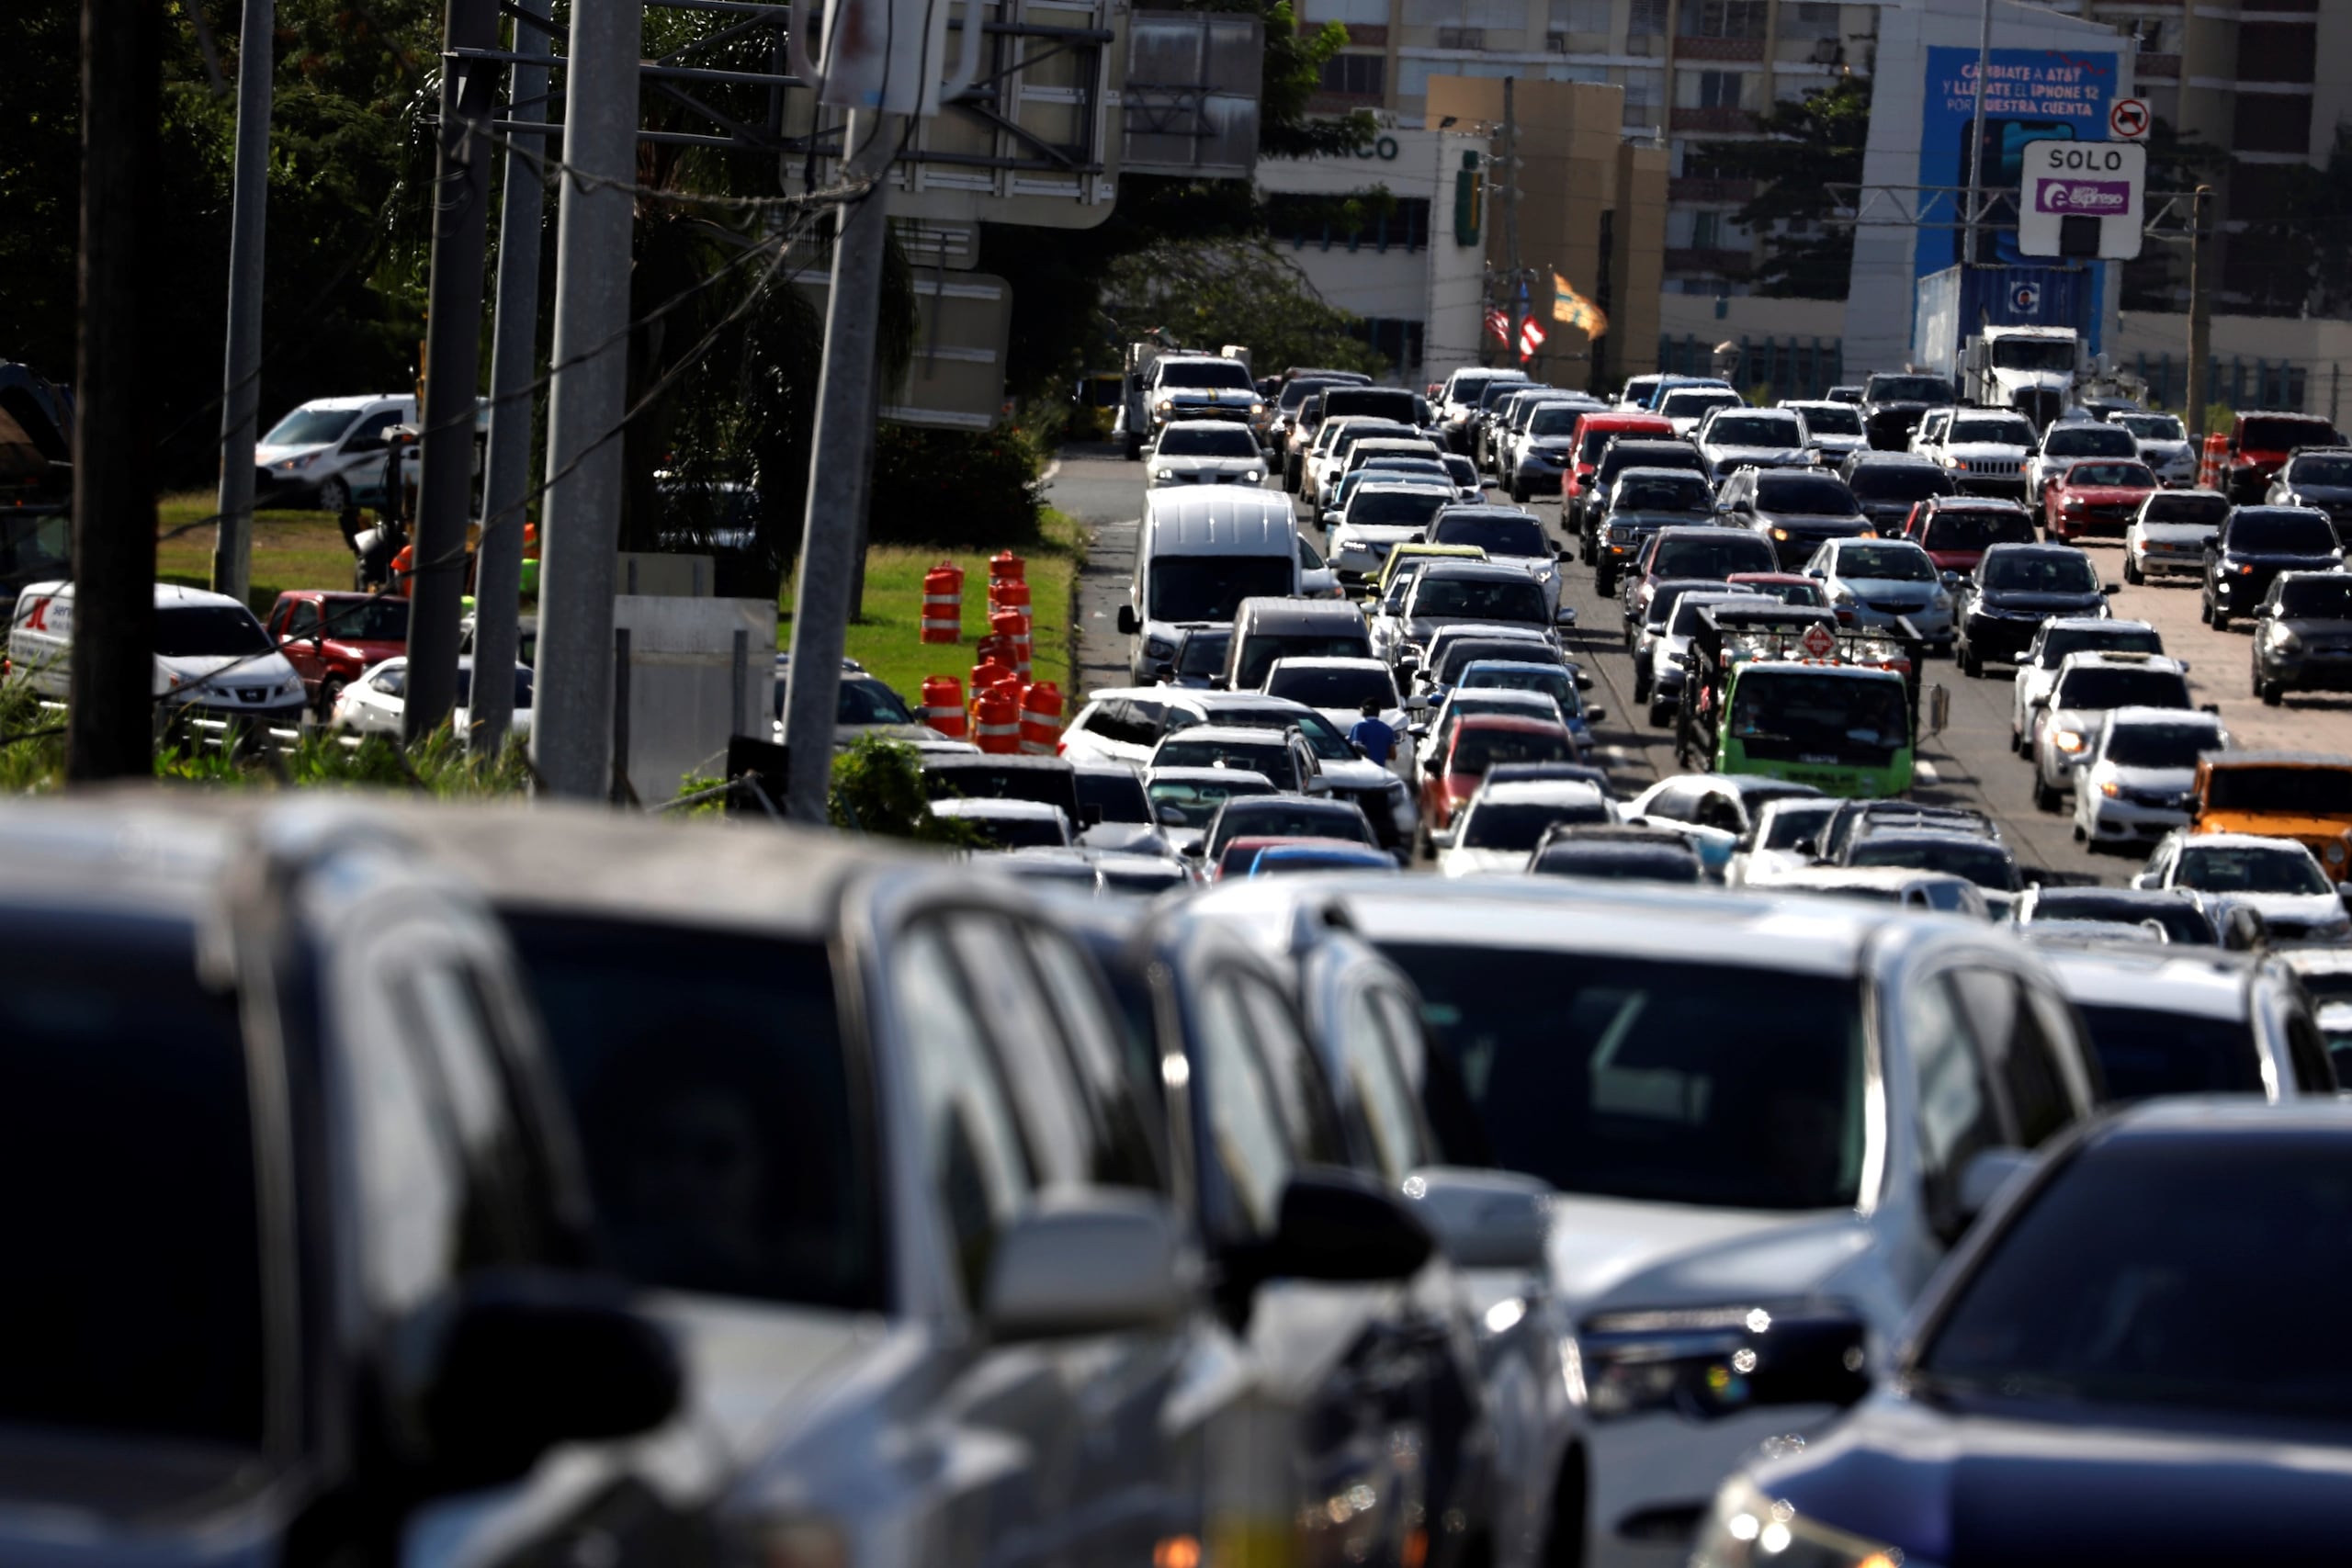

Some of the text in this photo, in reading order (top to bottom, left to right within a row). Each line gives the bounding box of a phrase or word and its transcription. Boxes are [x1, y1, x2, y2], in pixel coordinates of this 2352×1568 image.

[2046, 67, 2082, 83] AT&T
[1953, 79, 2011, 97] LLÉATE
[2014, 85, 2028, 97] EL
[2084, 85, 2099, 100] 12
[1947, 98, 2093, 117] POR UESTRA CUENTA
[2049, 149, 2121, 171] SOLO
